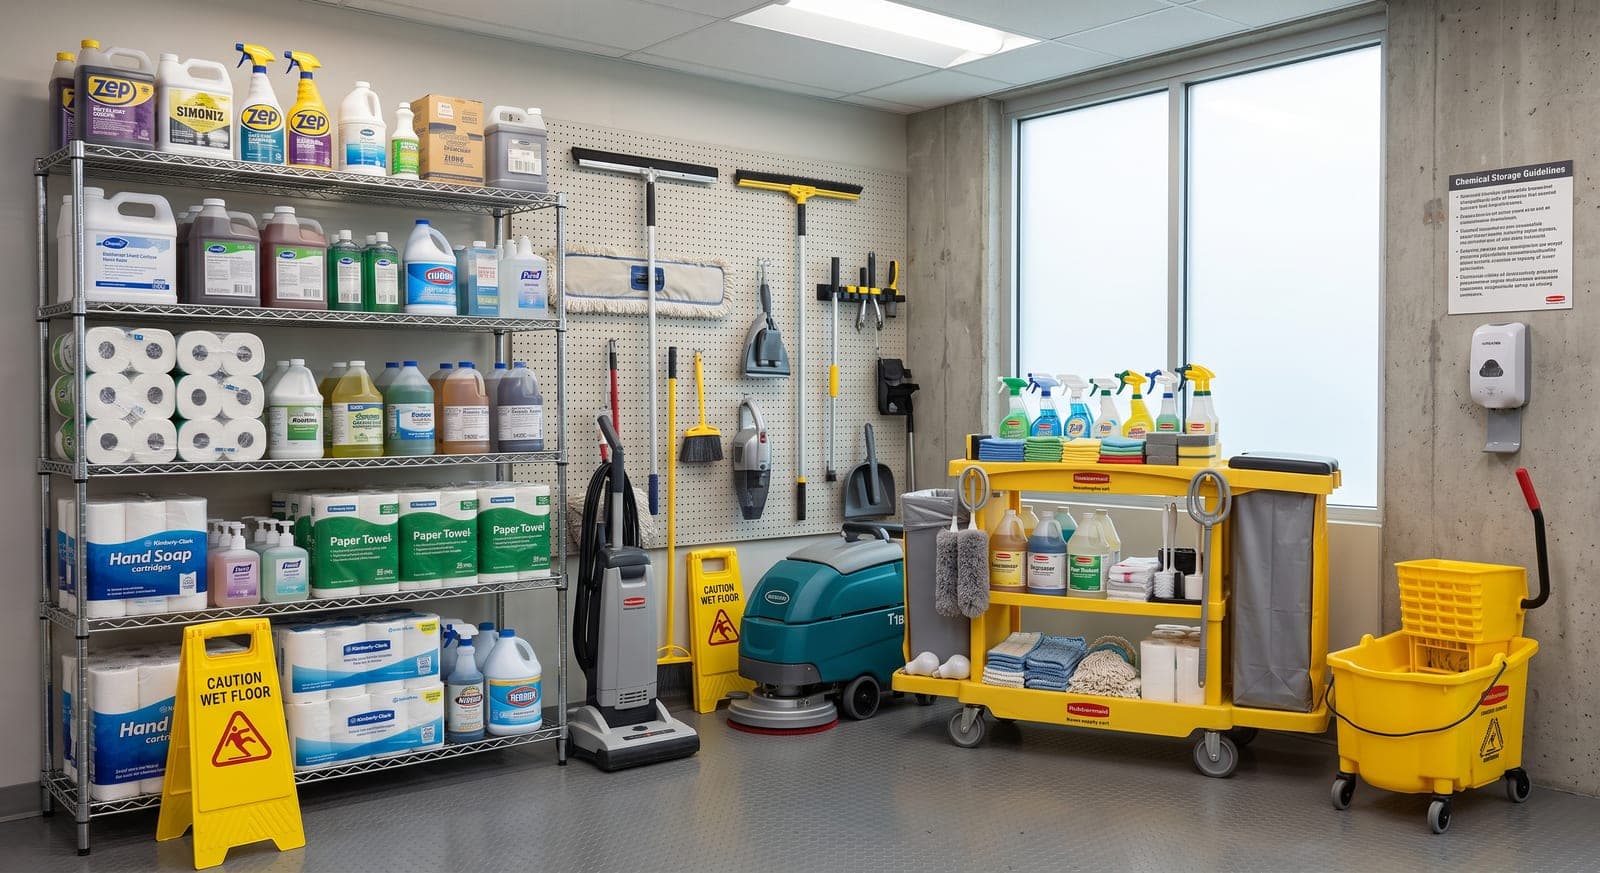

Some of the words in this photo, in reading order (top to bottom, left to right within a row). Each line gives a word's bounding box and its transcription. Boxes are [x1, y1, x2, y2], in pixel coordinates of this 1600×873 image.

[176, 106, 224, 122] SIMONIZ
[1455, 175, 1490, 186] Chemical
[1491, 171, 1522, 182] Storage
[1523, 166, 1566, 178] Guidelines
[413, 531, 442, 542] Paper
[443, 527, 471, 538] Towel
[493, 525, 519, 536] Paper
[520, 522, 545, 532] Towel
[330, 536, 361, 548] Paper
[361, 532, 392, 545] Towel
[109, 549, 152, 566] Hand
[153, 549, 192, 564] Soap
[131, 563, 172, 573] cartridges
[703, 583, 735, 595] CAUTION
[700, 595, 716, 605] WET
[717, 593, 740, 603] FLOOR
[207, 671, 262, 690] CAUTION
[200, 691, 227, 707] WET
[231, 685, 271, 702] FLOOR
[119, 716, 169, 738] Hand
[145, 734, 171, 744] cartri
